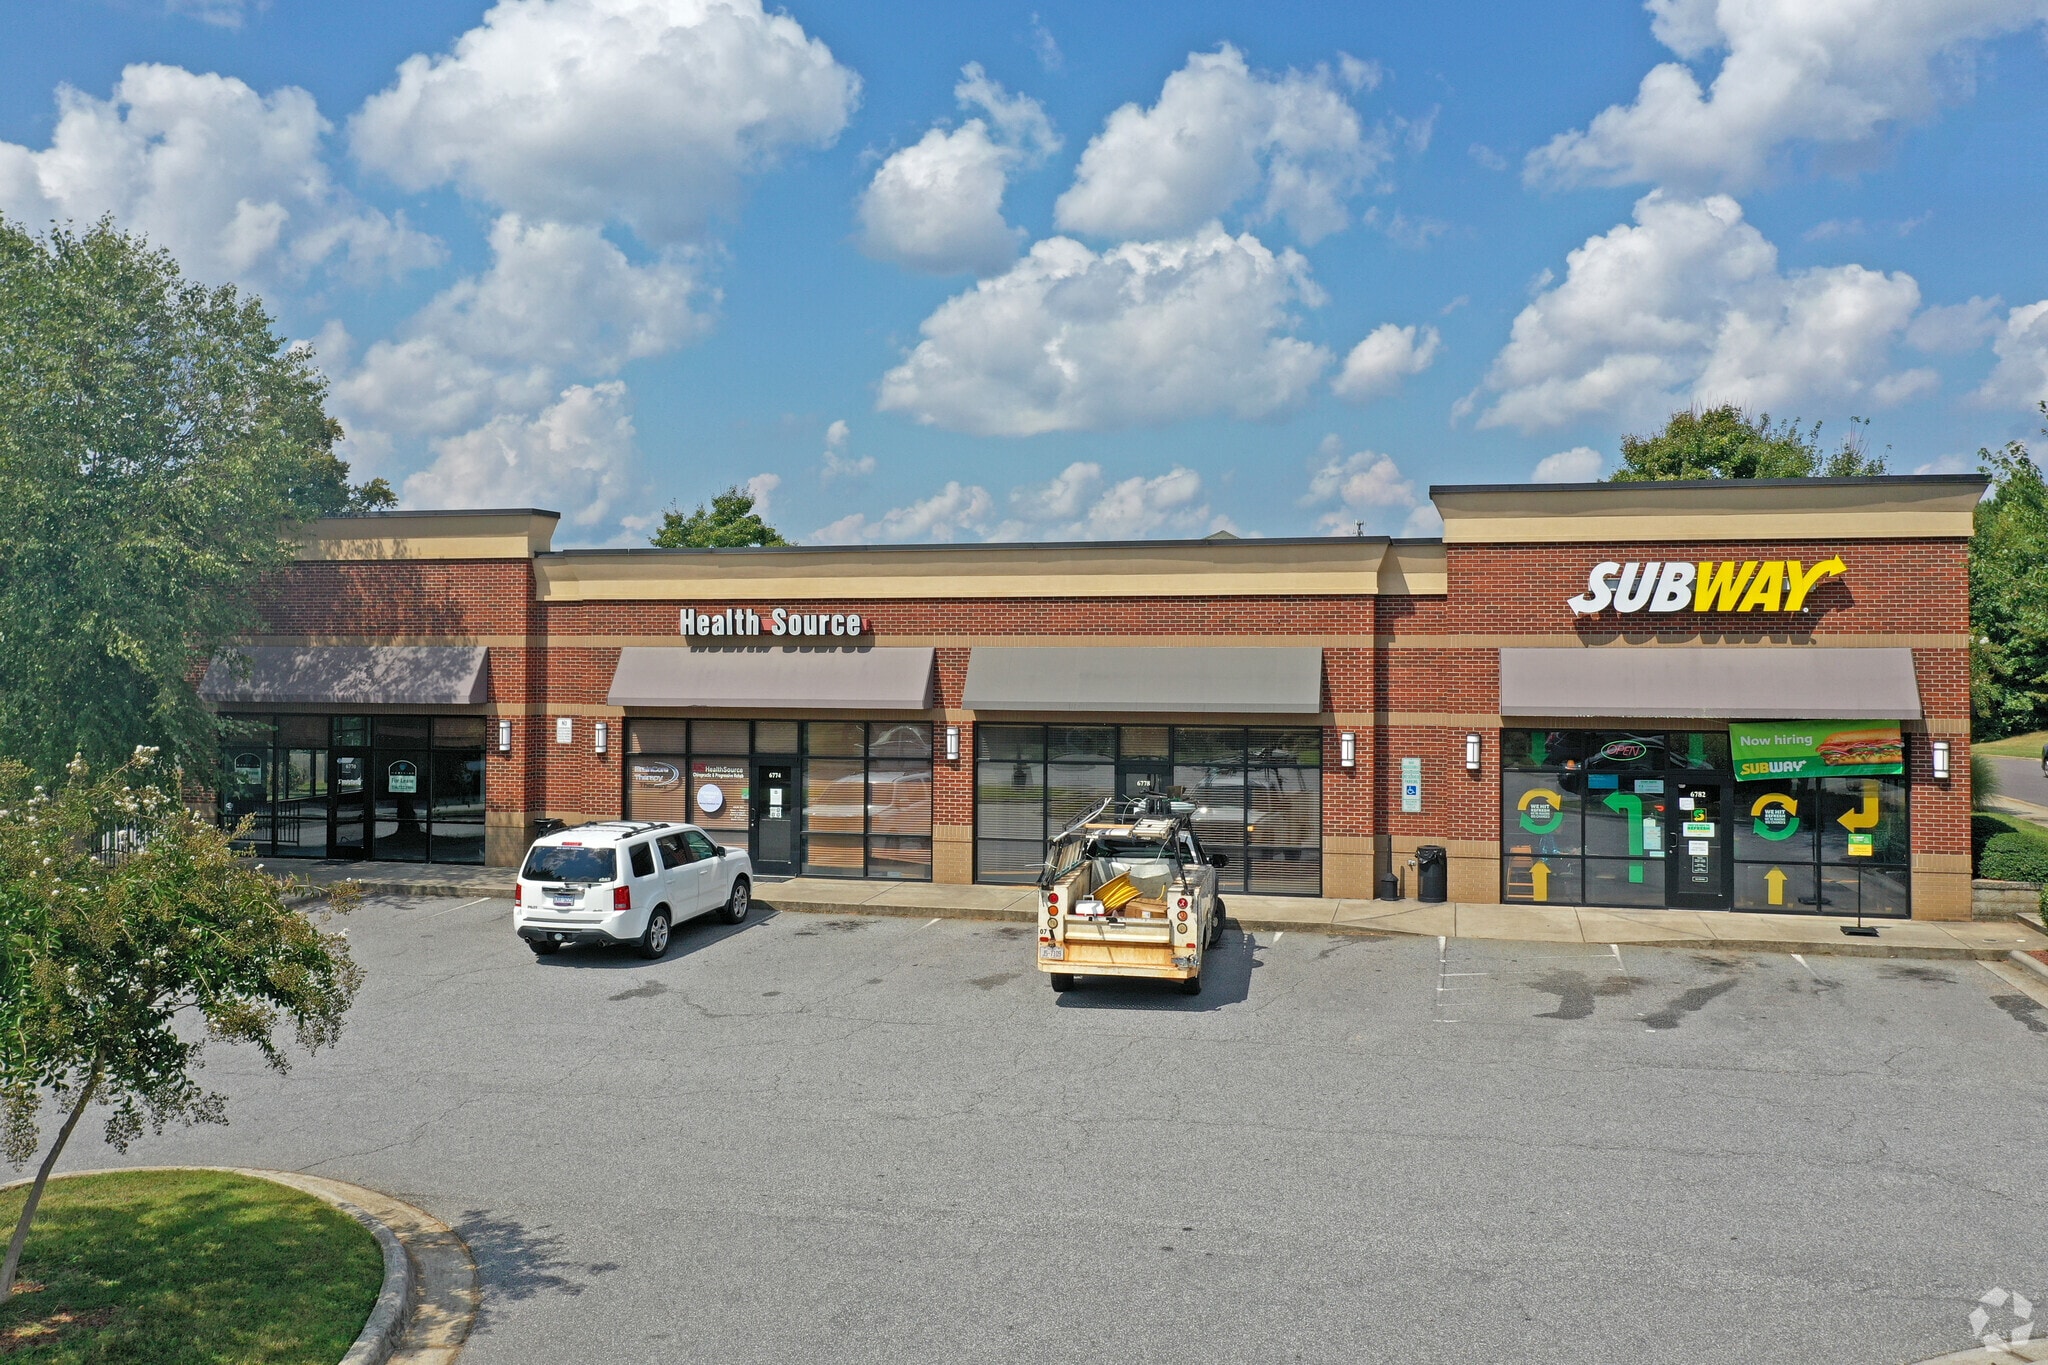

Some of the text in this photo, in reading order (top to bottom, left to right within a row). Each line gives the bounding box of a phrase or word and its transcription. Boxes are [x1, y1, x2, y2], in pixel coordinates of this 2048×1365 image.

[1567, 554, 1847, 617] SUBWAY
[680, 608, 861, 636] Health Source
[1740, 734, 1813, 746] Now hiring
[1607, 744, 1640, 756] OPEN
[1740, 760, 1807, 775] SUBWAY
[634, 774, 664, 782] Therapy
